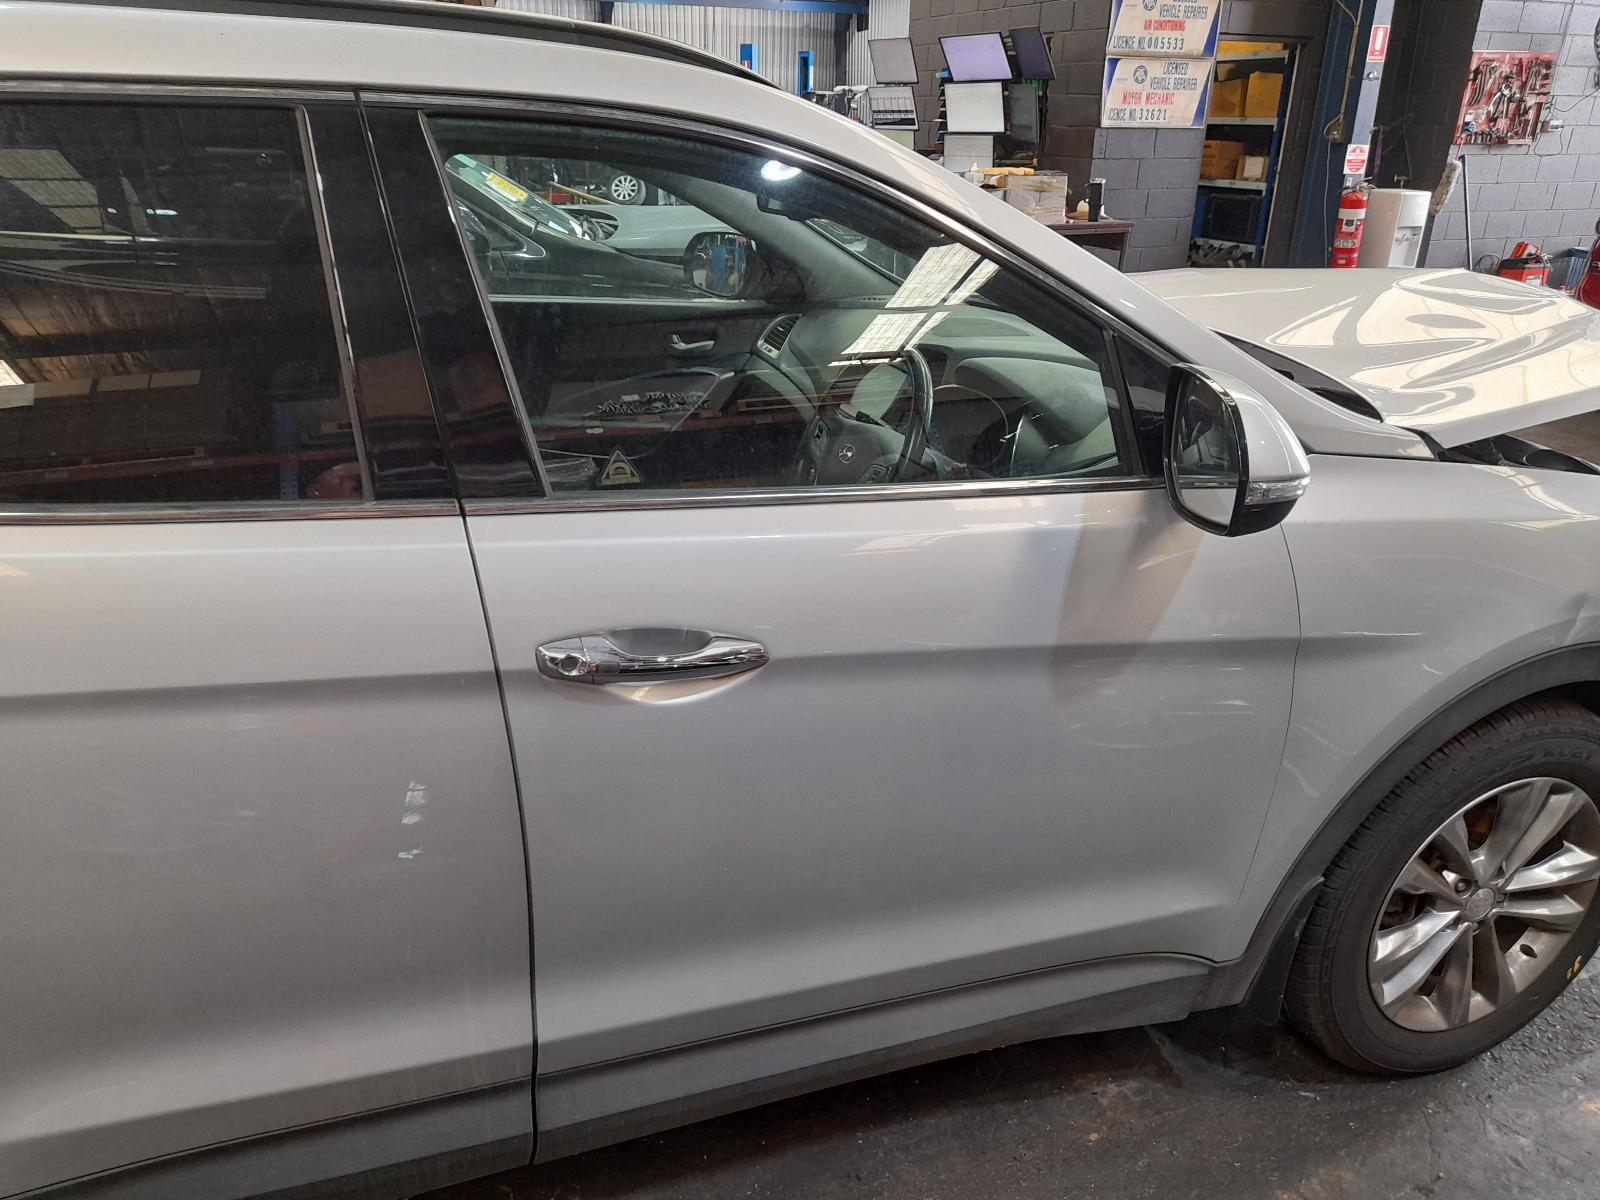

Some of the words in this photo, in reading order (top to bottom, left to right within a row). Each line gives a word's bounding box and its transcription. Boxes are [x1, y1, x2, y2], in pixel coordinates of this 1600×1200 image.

[1160, 4, 1181, 18] VEHICLE
[1183, 5, 1208, 19] REPAIRER
[1153, 20, 1185, 31] CONDITIONING
[1163, 62, 1188, 75] LICENSED
[1150, 77, 1171, 90] VEHICLE
[1173, 78, 1197, 90] REPAIRER
[1122, 91, 1142, 105] MOTOR
[1145, 92, 1174, 105] MECHANIC
[1139, 108, 1167, 120] 32621
